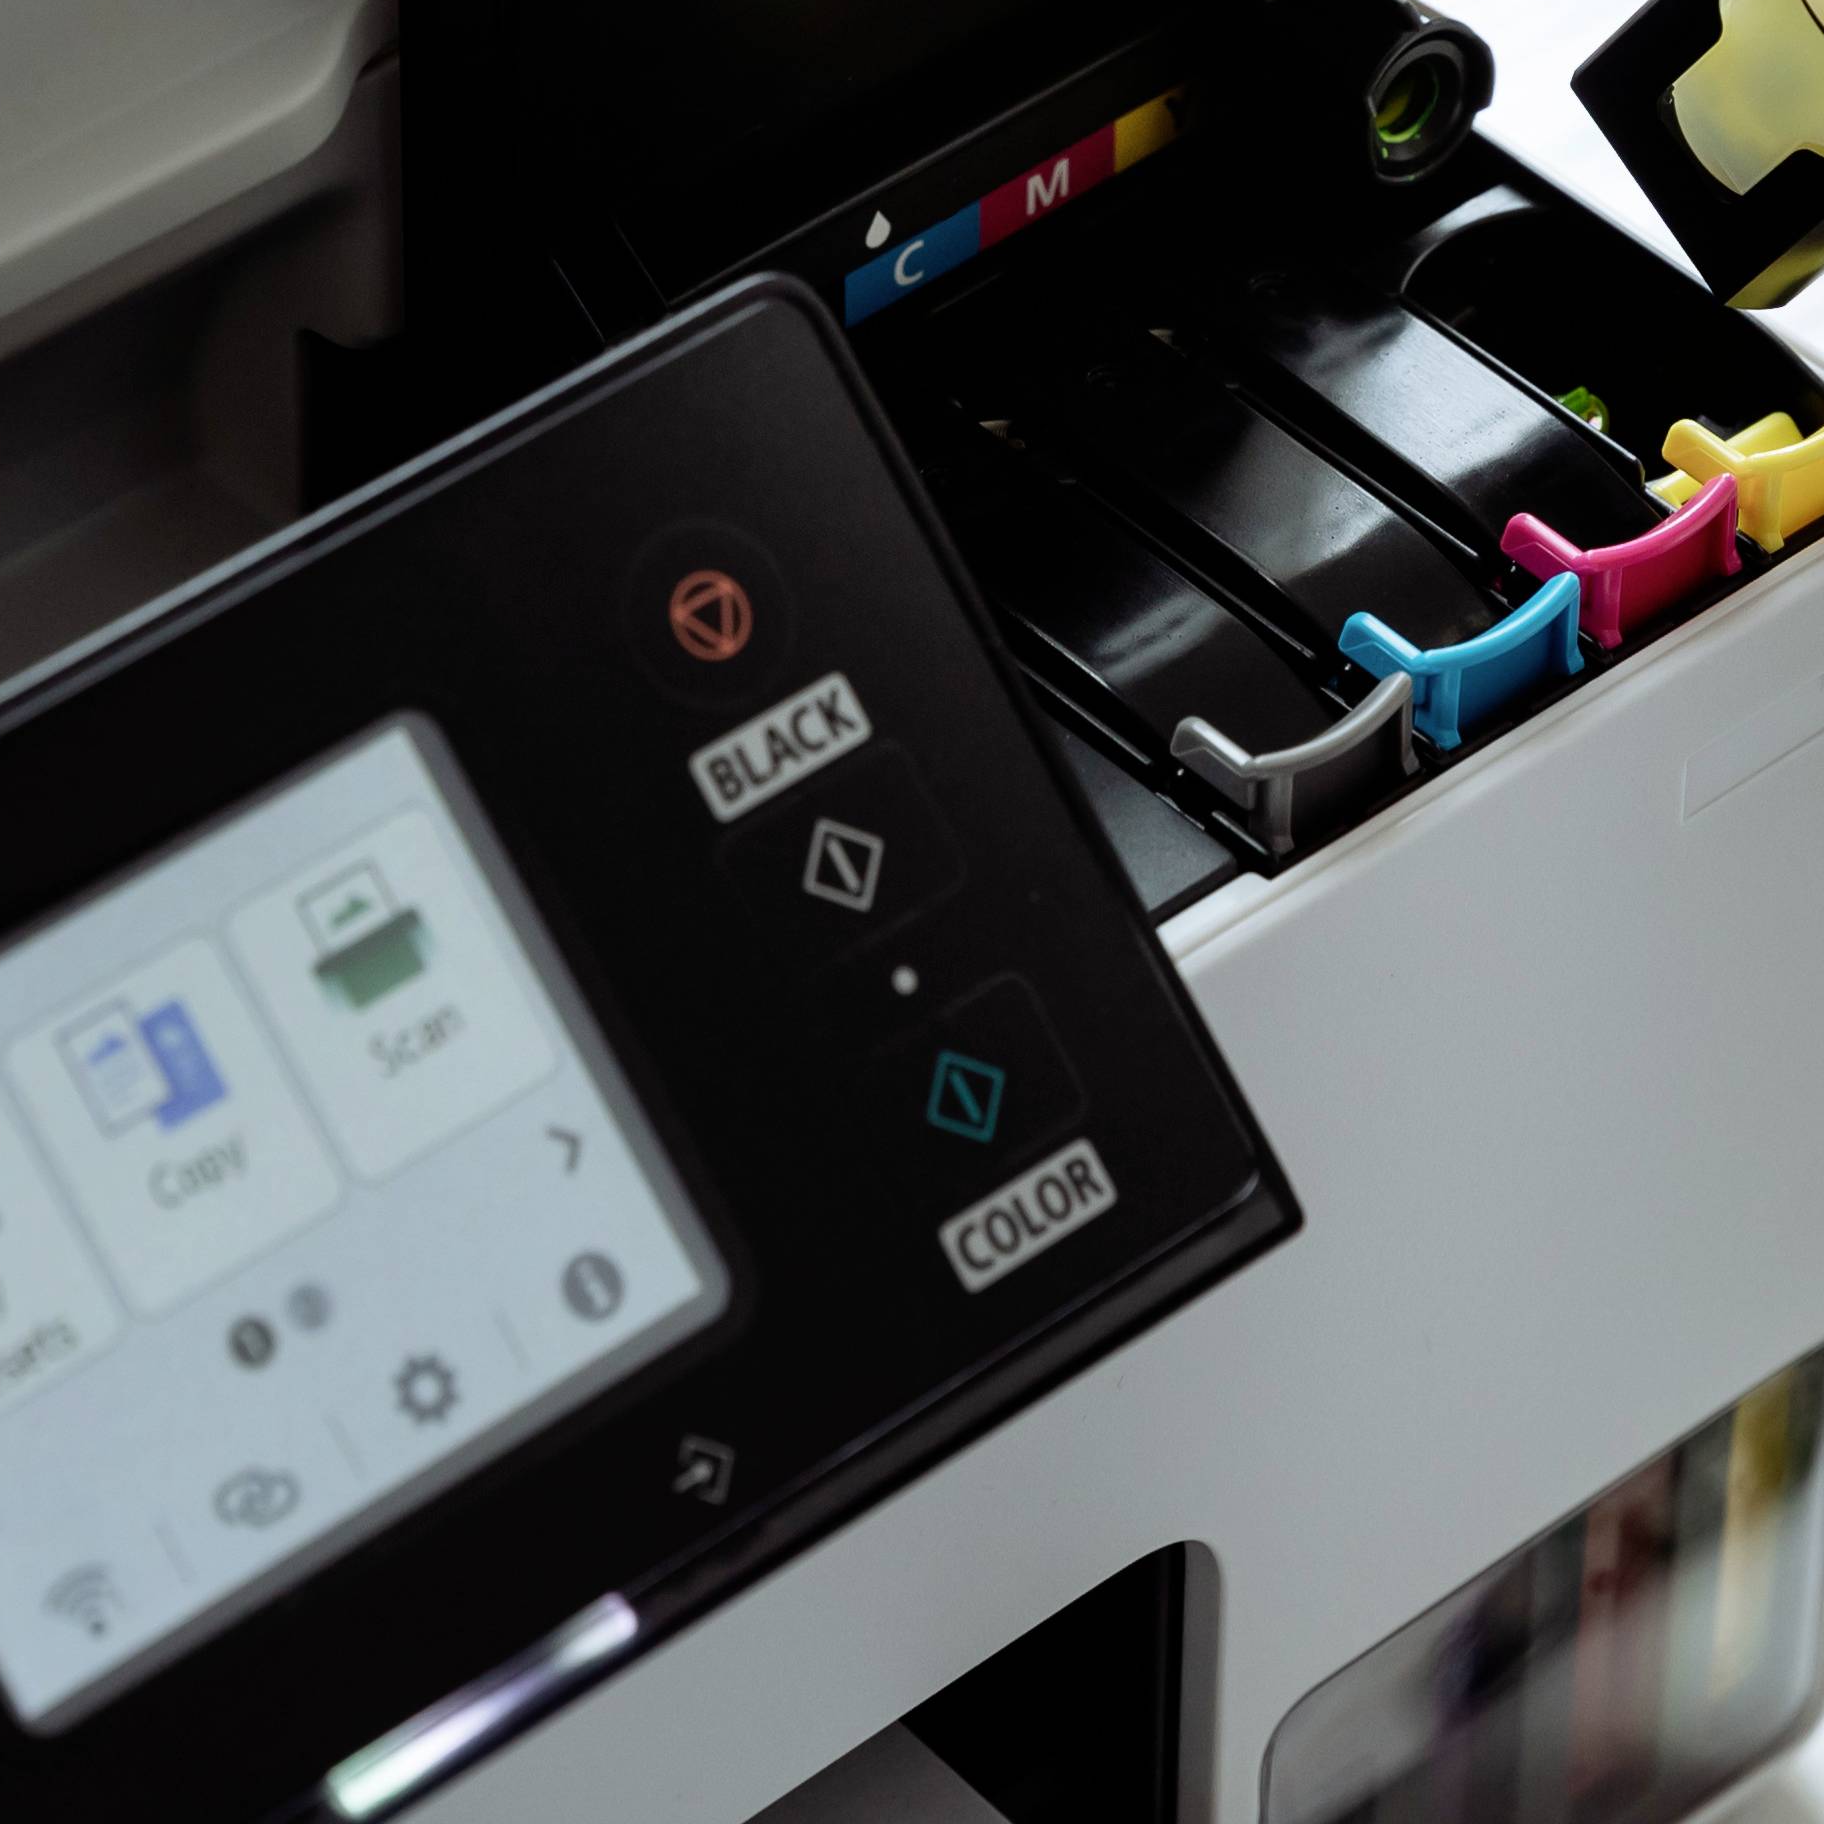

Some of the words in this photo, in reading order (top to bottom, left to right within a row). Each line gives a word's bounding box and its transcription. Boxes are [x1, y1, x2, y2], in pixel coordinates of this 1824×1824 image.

[893, 239, 925, 286] C
[1025, 157, 1070, 216] M
[707, 687, 859, 805] BLACK
[367, 1004, 466, 1079] Scan
[145, 1134, 248, 1212] Copy
[957, 1157, 1105, 1271] COLOR
